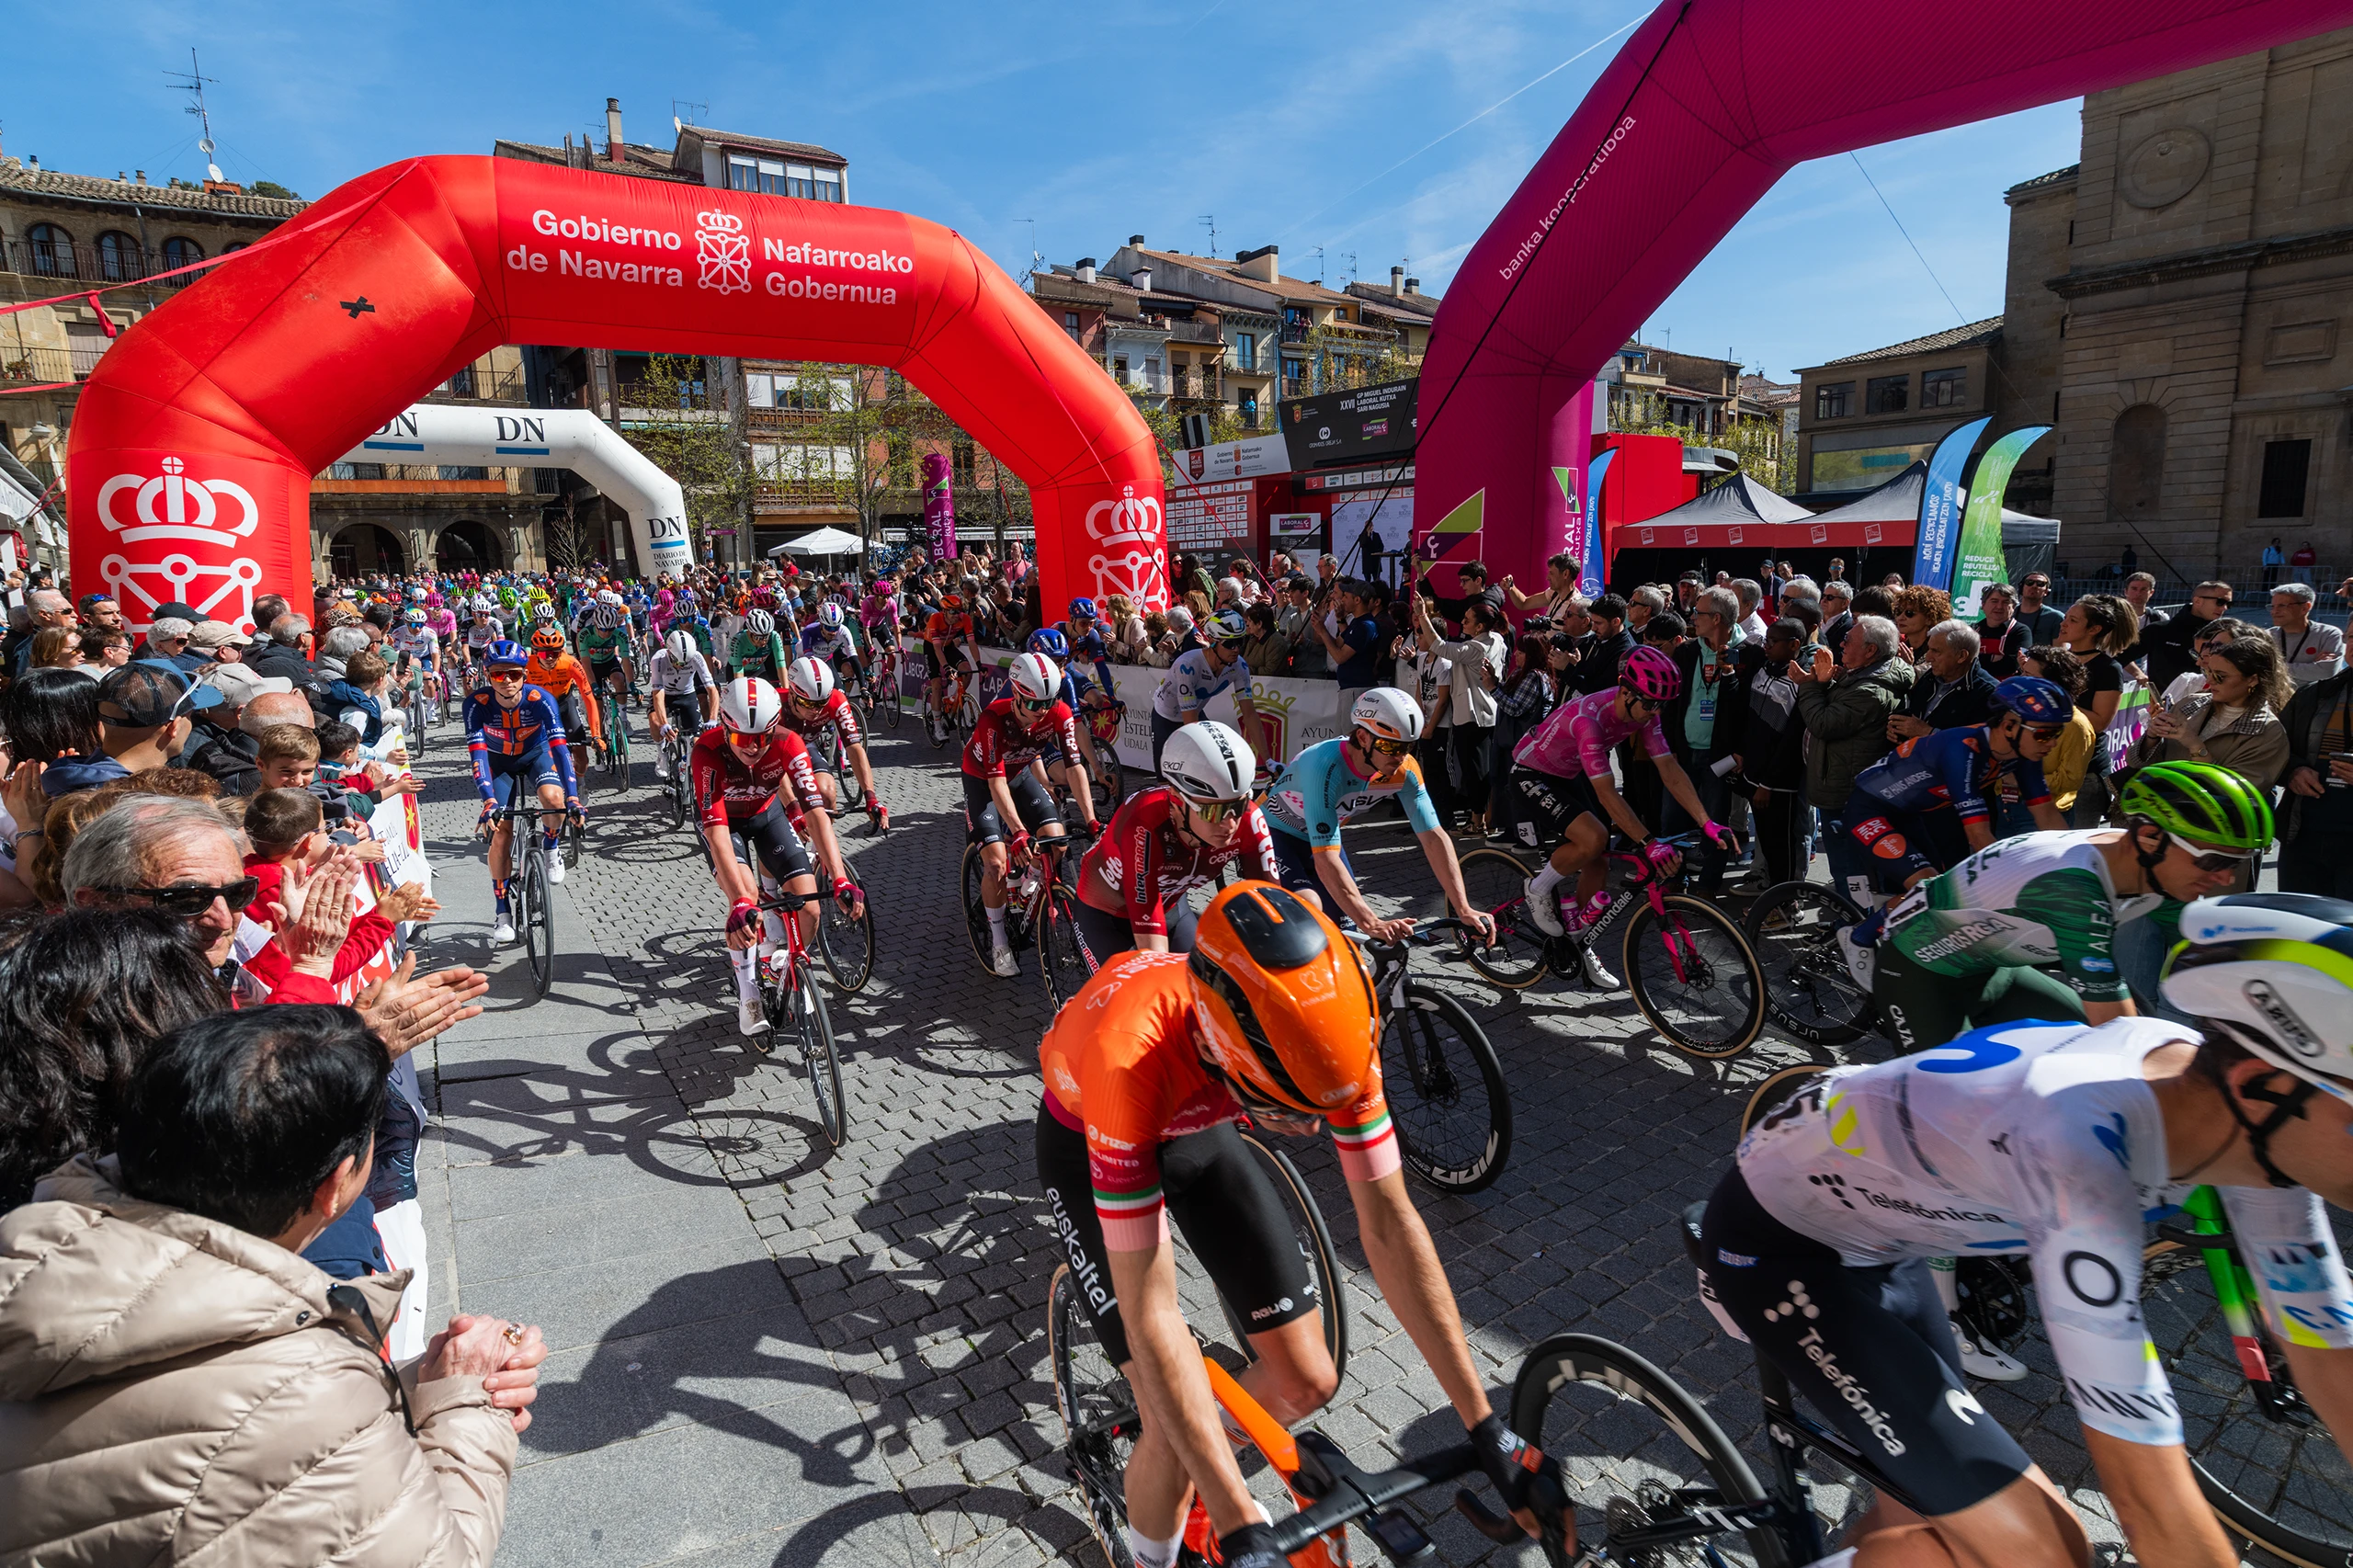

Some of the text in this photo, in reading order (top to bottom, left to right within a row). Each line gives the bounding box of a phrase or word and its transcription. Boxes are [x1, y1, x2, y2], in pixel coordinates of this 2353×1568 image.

[1499, 116, 1636, 280] banka kooperatiboa
[532, 210, 682, 250] Gobierno
[506, 244, 684, 287] de Navarra
[764, 237, 914, 274] Nafarroako
[766, 272, 897, 305] Gobernua
[1357, 393, 1396, 405] LABORAL KUTXA
[1364, 390, 1381, 398] MIGUEL
[1382, 384, 1407, 394] INDURAIN
[1340, 399, 1355, 411] XXVII
[1369, 403, 1390, 411] NAGUSIA
[494, 416, 545, 443] DN
[1242, 446, 1262, 454] Nafarroako
[646, 516, 682, 539] DN
[943, 510, 951, 537] kutxa
[1925, 494, 1939, 541] RECICLAMOS
[654, 551, 678, 560] DIARIO
[1963, 562, 2000, 571] REUTILIZA
[835, 701, 857, 732] lotto
[1035, 728, 1054, 741] caps
[1123, 737, 1148, 751] UDALA
[1539, 722, 1561, 751] cannondale
[762, 766, 784, 780] caps
[789, 752, 817, 791] lotto
[1891, 770, 1933, 796] HANS ANDERS
[1518, 827, 1529, 837] 25
[1866, 819, 1886, 834] PIC
[1209, 847, 1240, 866] caps
[1250, 805, 1279, 881] lotto
[1880, 840, 1902, 856] postnl
[1849, 882, 1861, 892] 75
[1583, 890, 1633, 946] cannondale
[2088, 900, 2114, 953] ALEA
[1914, 929, 1969, 963] SEGUROS
[1889, 1005, 1915, 1048] CAJA
[1854, 1187, 2007, 1224] Telefónica
[1045, 1187, 1120, 1317] euskaltel
[1797, 1326, 1906, 1458] Telefónica
